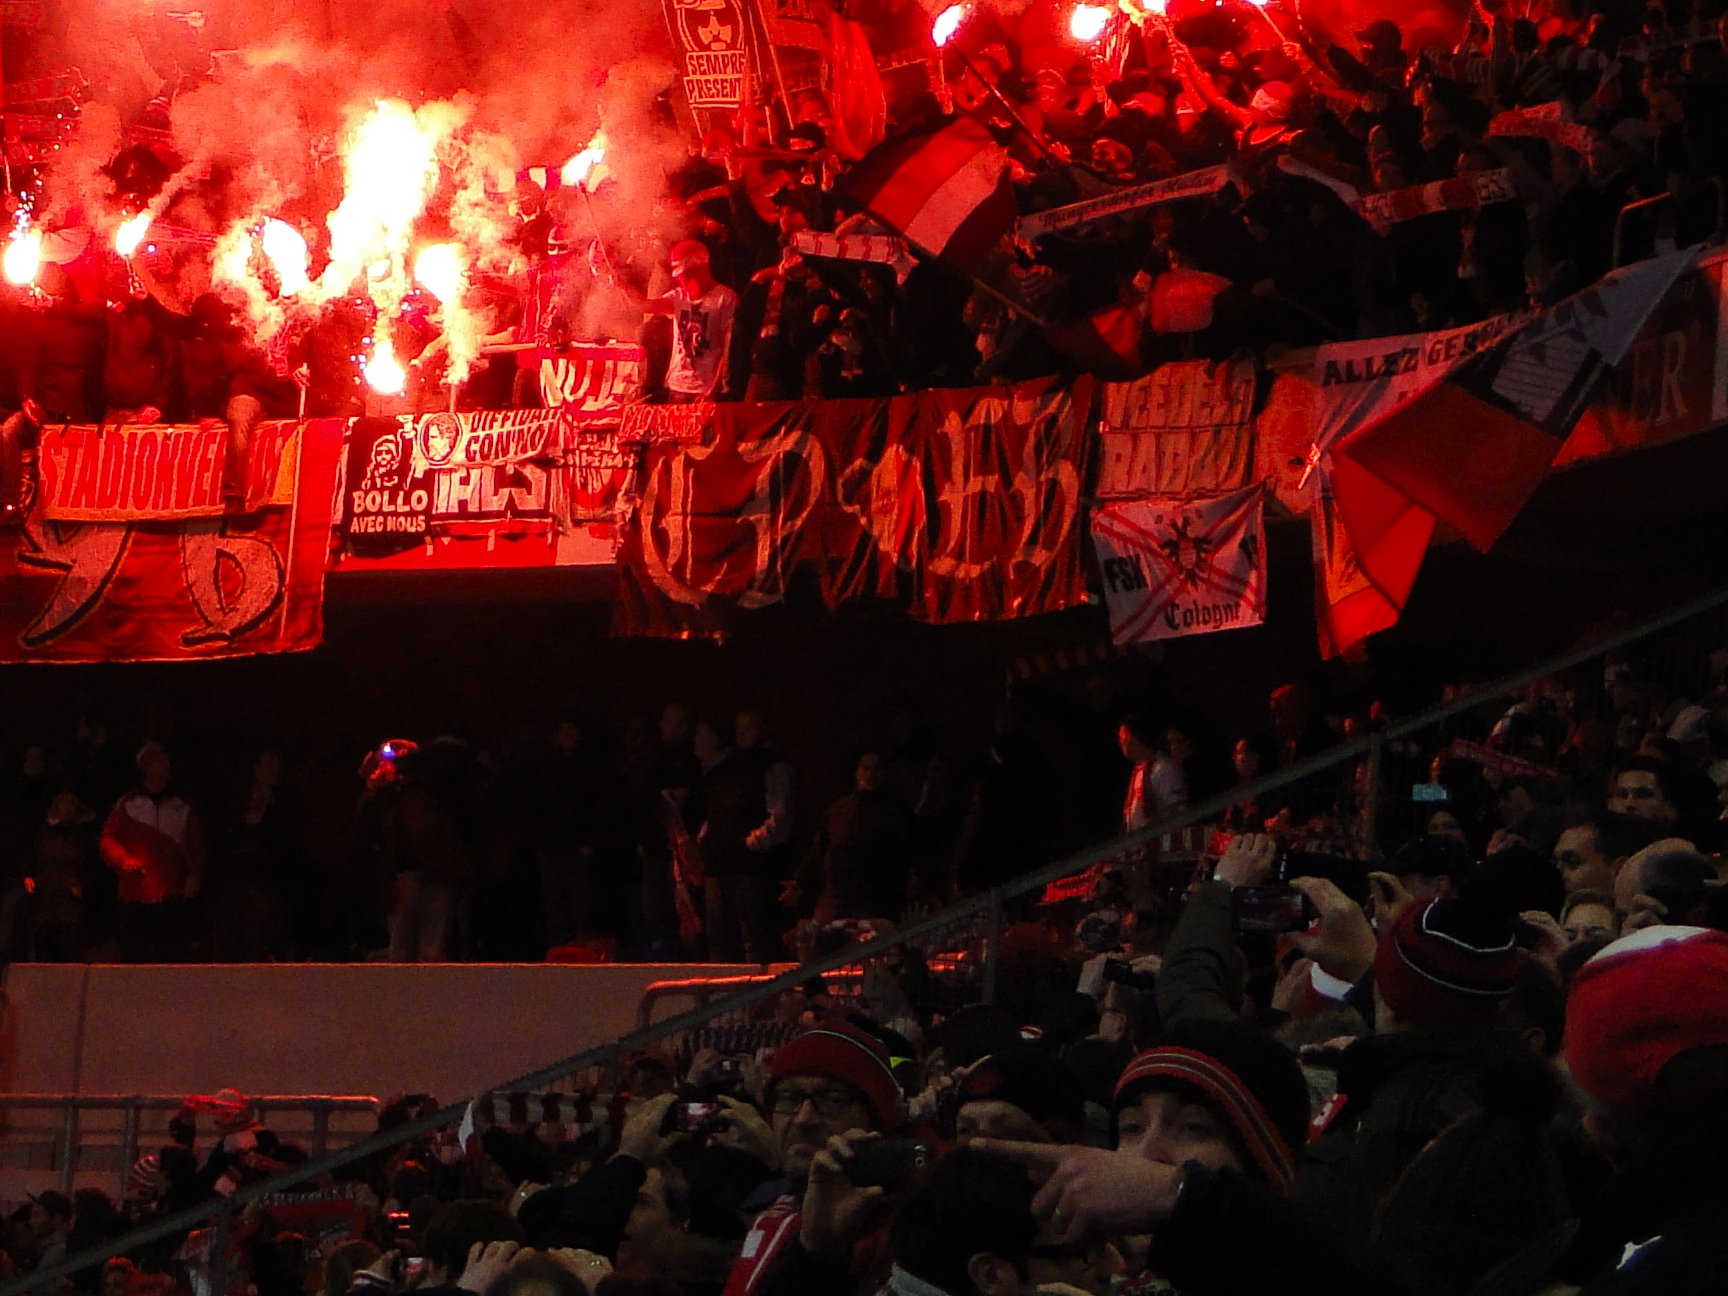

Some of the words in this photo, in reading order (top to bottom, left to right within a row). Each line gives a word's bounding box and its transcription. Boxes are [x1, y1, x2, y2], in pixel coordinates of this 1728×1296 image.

[685, 77, 754, 101] PRESENT
[1320, 346, 1421, 387] ALLEZ
[352, 489, 430, 514] BOLLO
[350, 516, 384, 534] AVEC
[386, 515, 427, 533] NOUS
